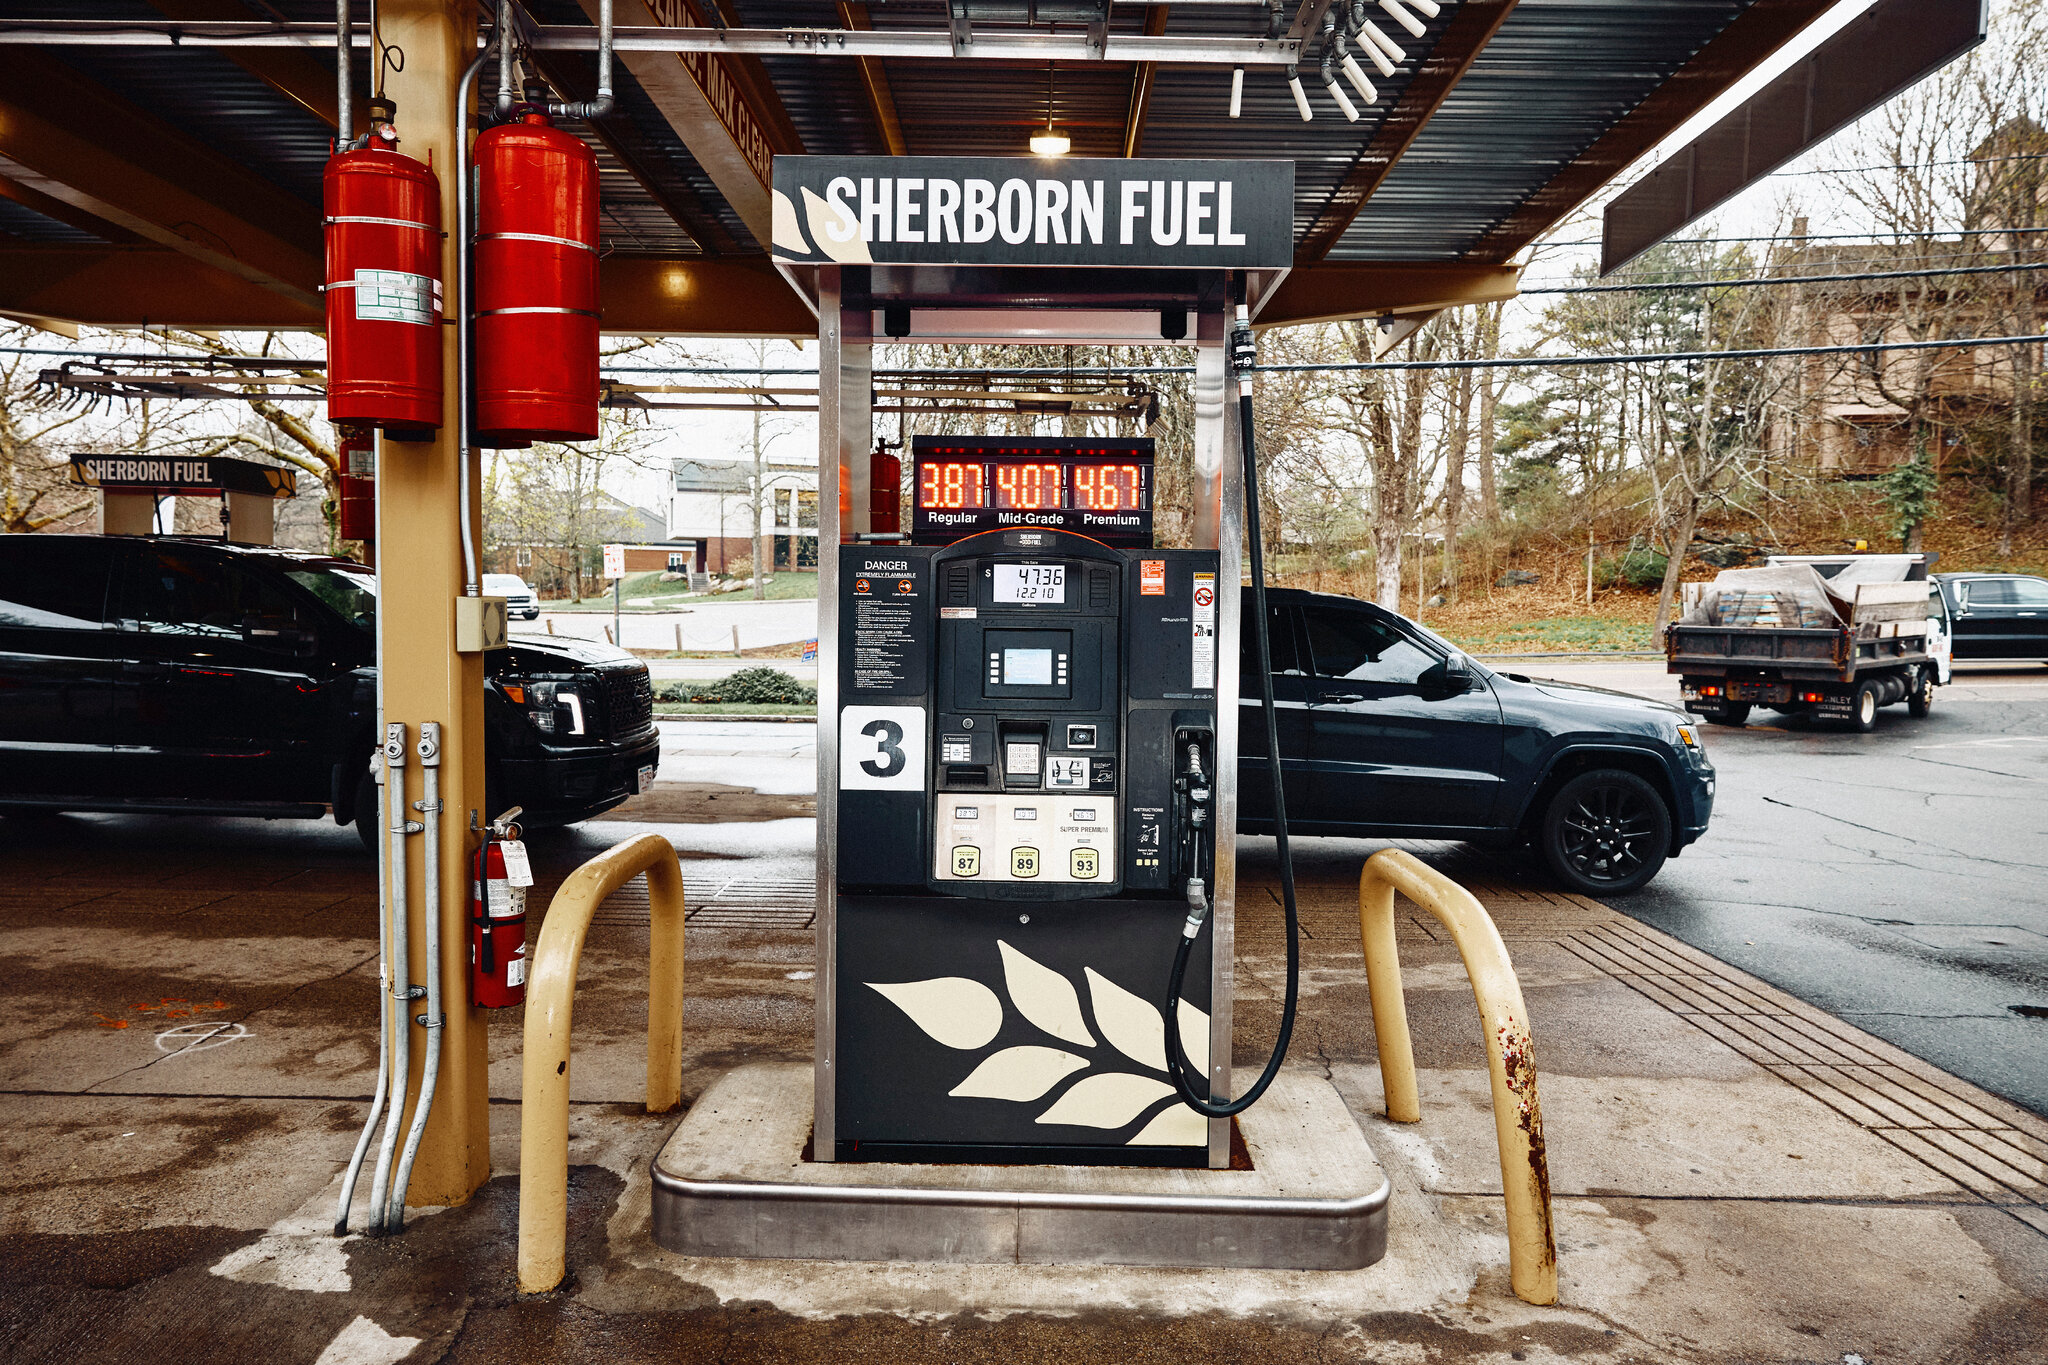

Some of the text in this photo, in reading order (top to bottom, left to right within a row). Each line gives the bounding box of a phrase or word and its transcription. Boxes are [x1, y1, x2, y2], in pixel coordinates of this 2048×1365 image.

[707, 52, 734, 135] MAX
[738, 101, 770, 188] CLEAR
[825, 176, 1246, 246] SHERBORN FUEL
[85, 460, 212, 483] SHERBORN FUEL
[928, 512, 978, 524] Regular
[998, 512, 1064, 525] Mid-Grade
[1083, 514, 1140, 526] Premium
[865, 561, 908, 570] DANGER
[1019, 568, 1063, 586] 47.36
[859, 719, 906, 778] 3
[958, 858, 974, 869] 87
[1017, 859, 1033, 869] 89
[1077, 860, 1093, 871] 93
